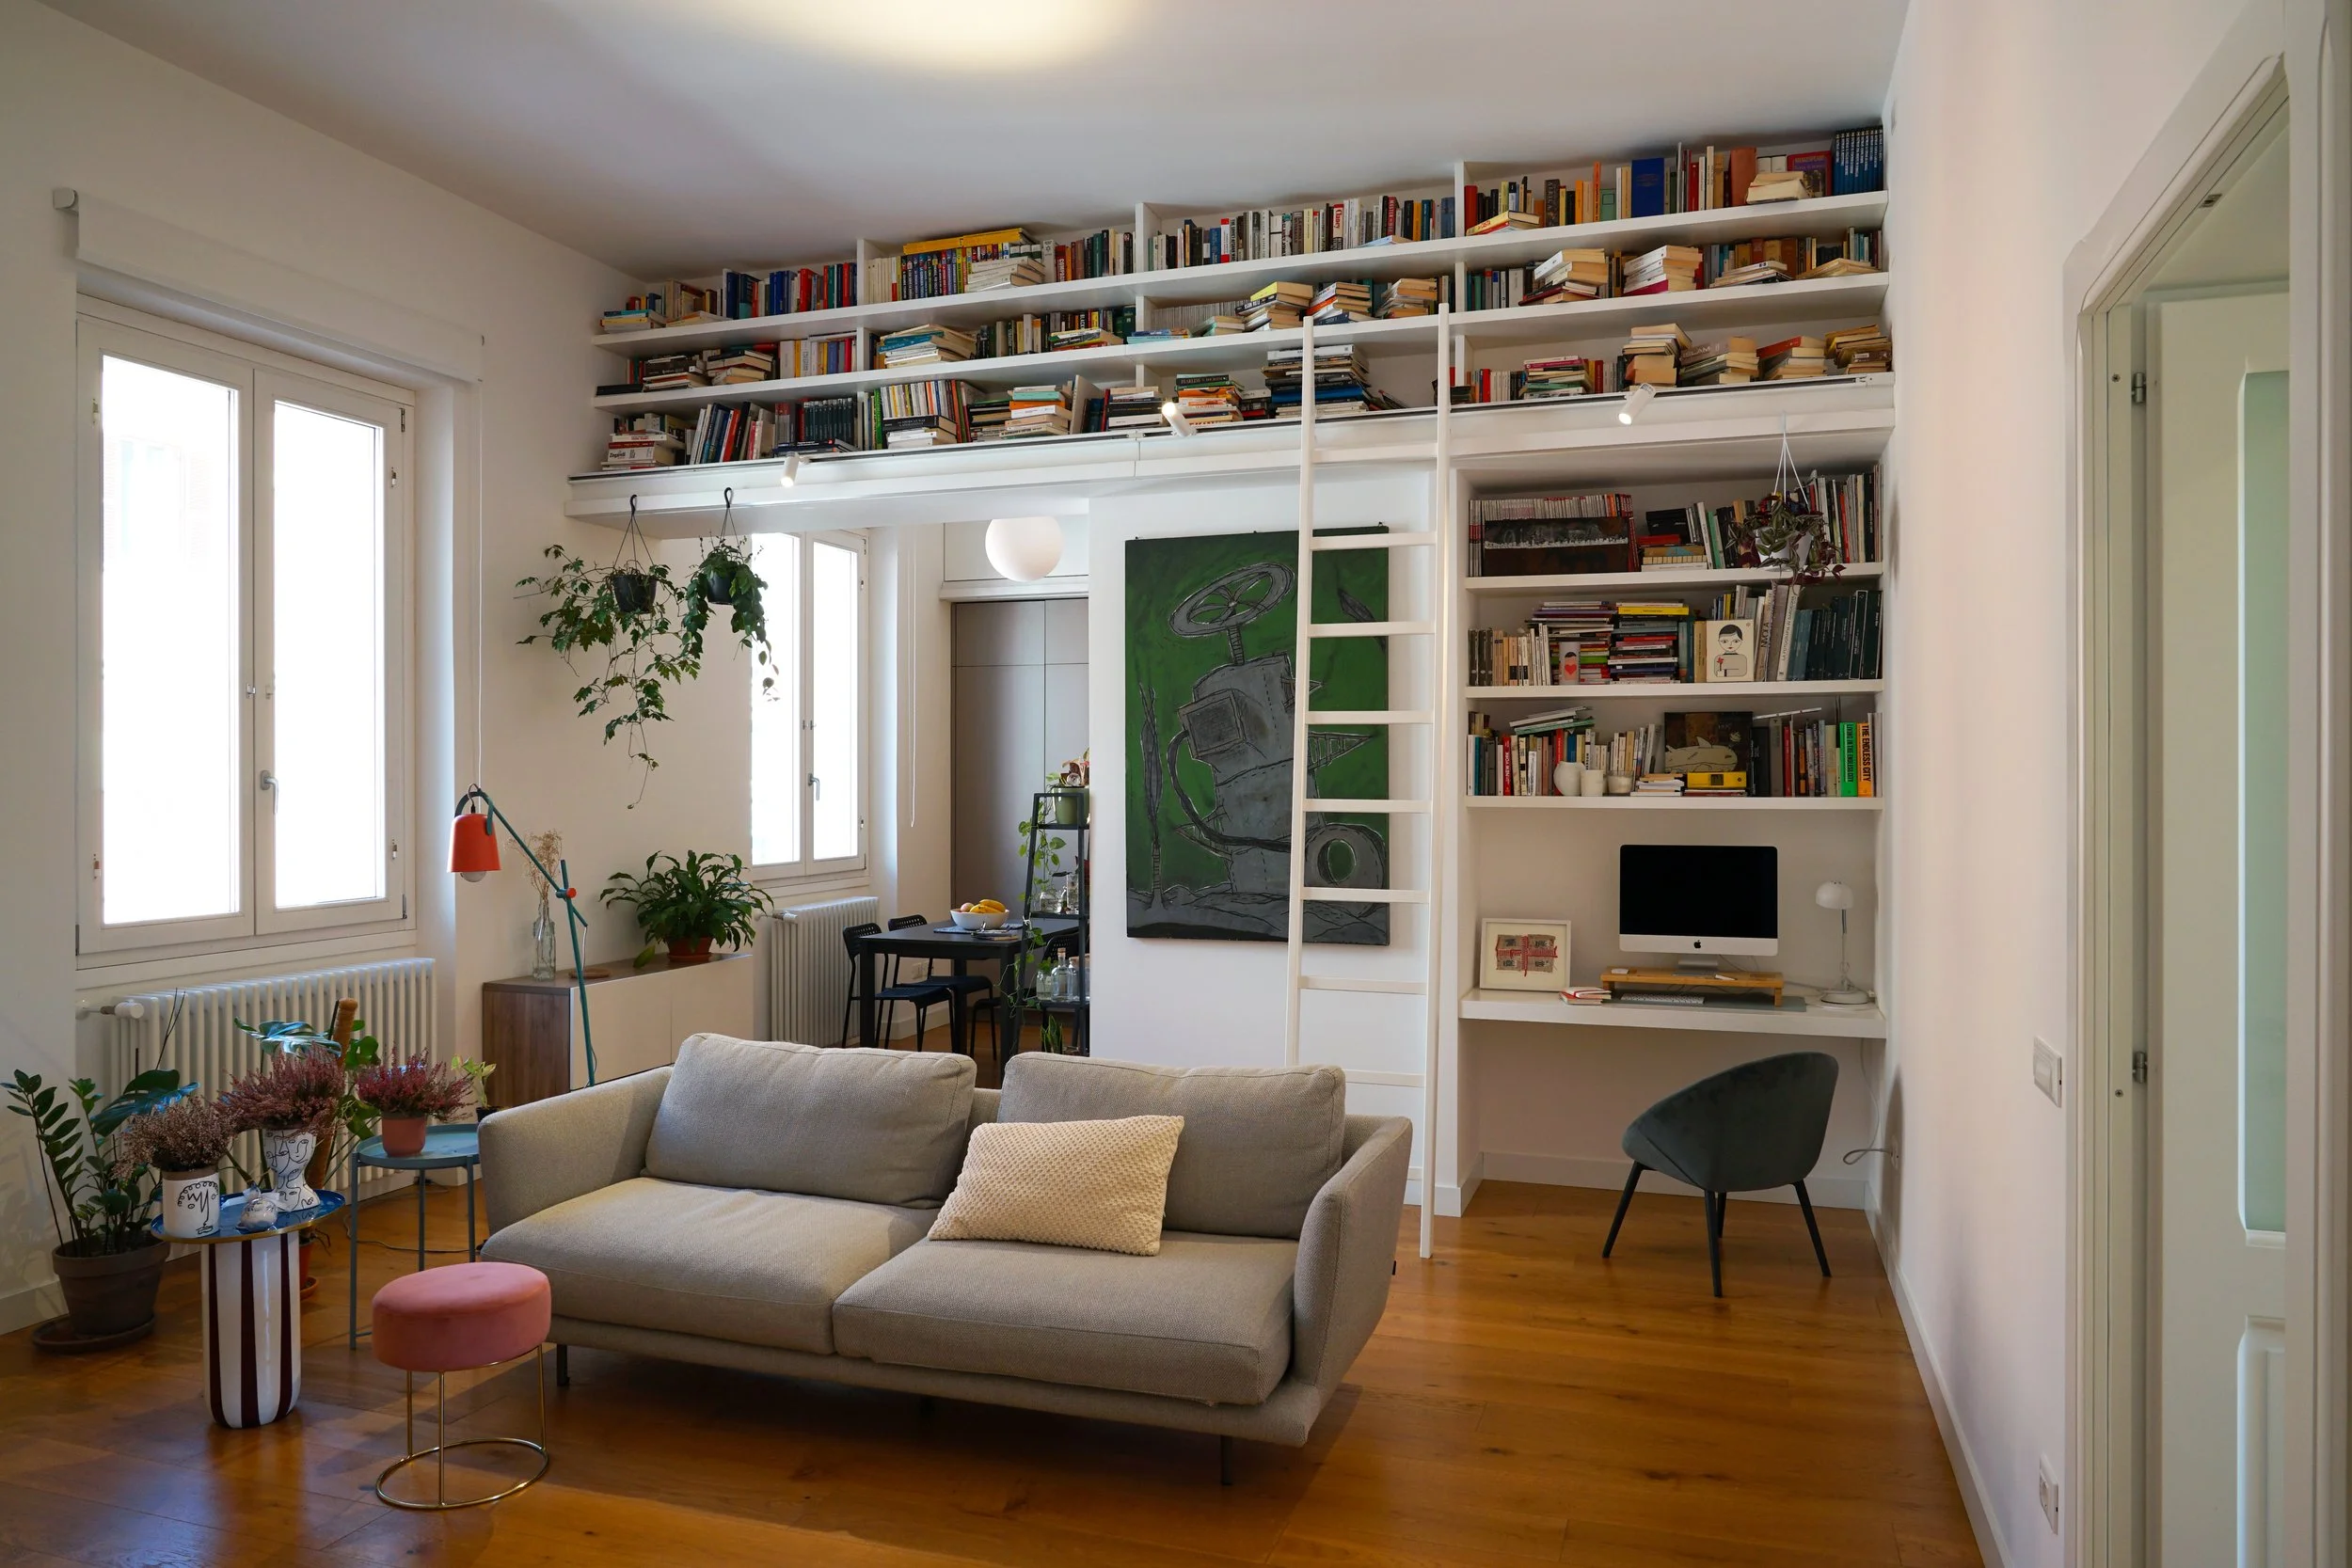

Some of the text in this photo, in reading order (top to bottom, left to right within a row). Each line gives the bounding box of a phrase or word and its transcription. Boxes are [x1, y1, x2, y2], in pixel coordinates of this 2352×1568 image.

[1334, 209, 1343, 229] Clancy
[1760, 622, 1770, 648] NIVOLA
[1862, 724, 1871, 782] THE ENDLESS CITY
